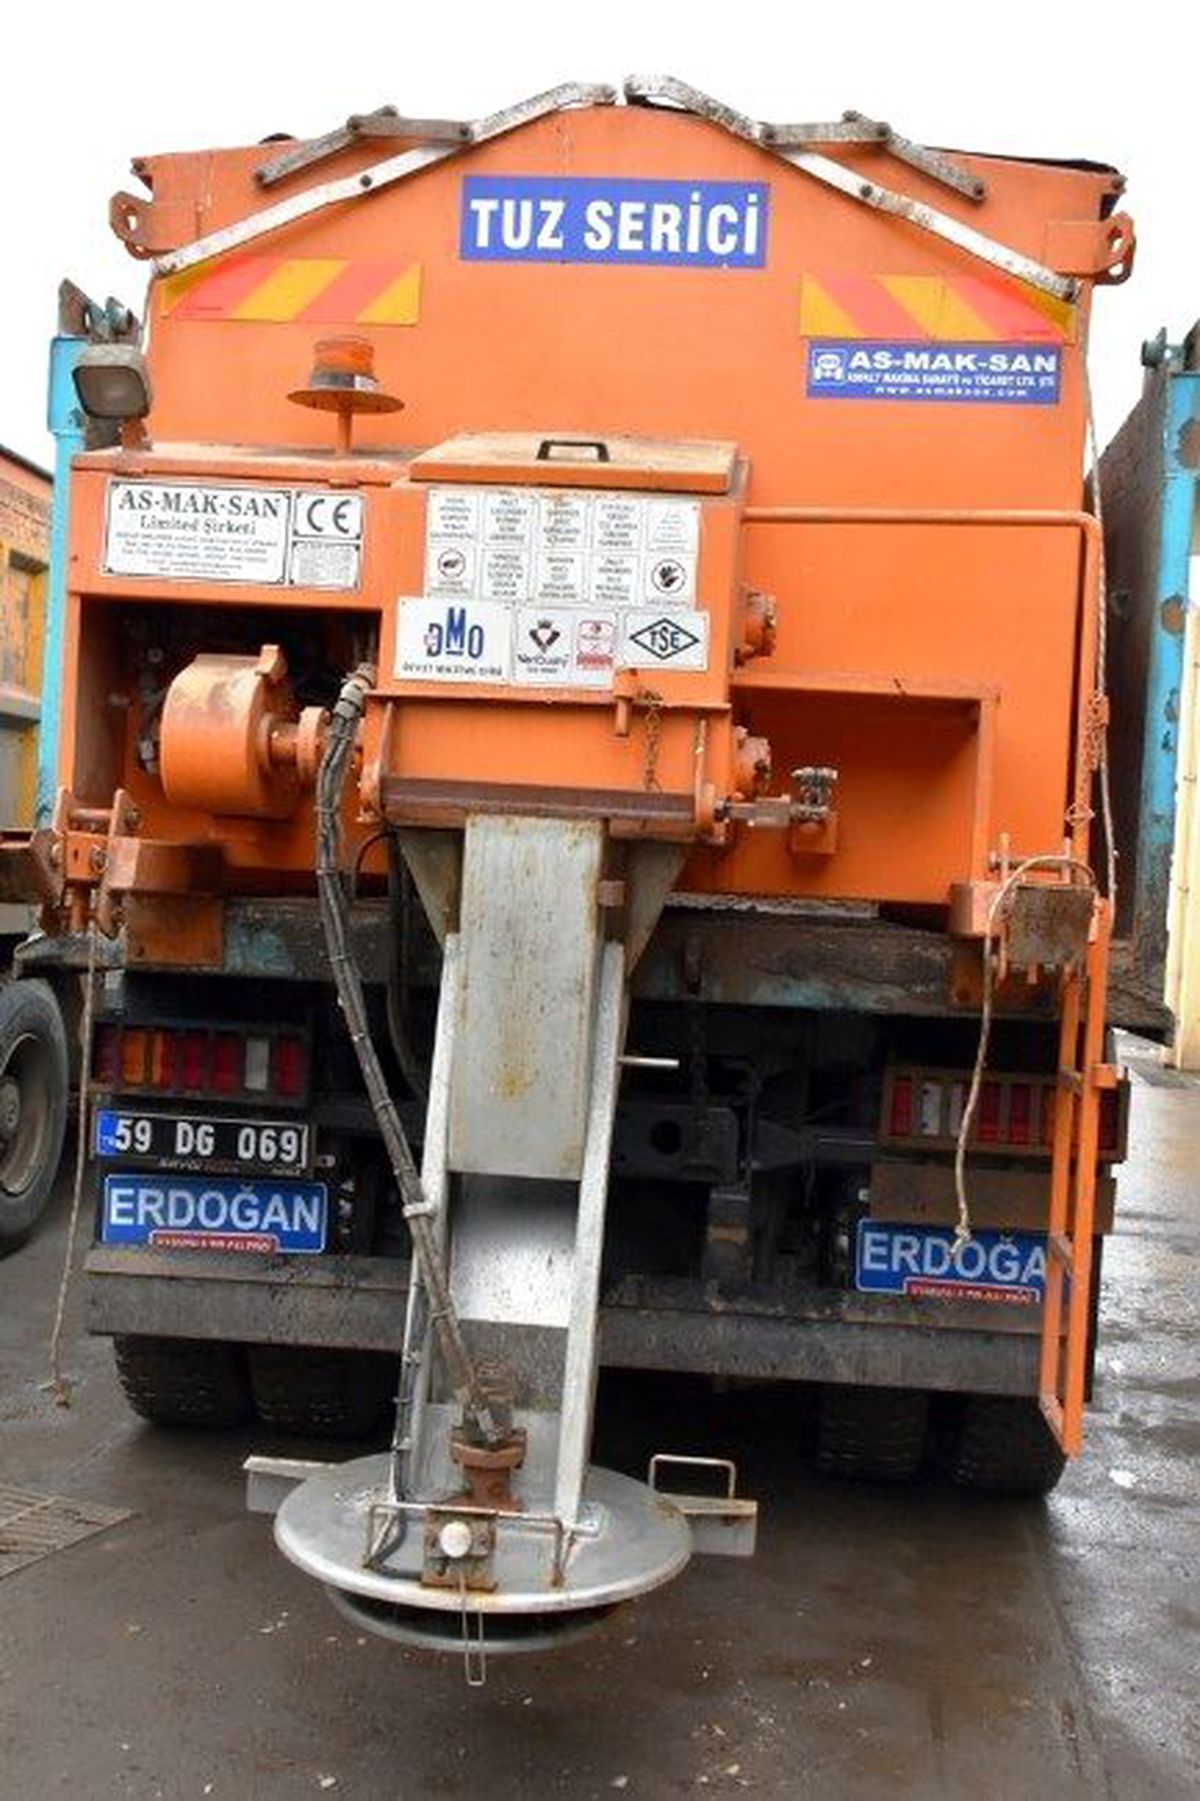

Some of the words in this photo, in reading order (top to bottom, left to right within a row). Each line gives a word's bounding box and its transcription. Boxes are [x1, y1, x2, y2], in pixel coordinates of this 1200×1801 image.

[470, 198, 566, 251] TUZ
[583, 190, 759, 256] SERİCİ
[849, 351, 1057, 373] AS-MAK-SAN
[118, 488, 281, 518] AS-MAK-SAN
[140, 514, 198, 533] Limited
[203, 517, 257, 536] Şirketi
[650, 625, 681, 652] TSE
[115, 1118, 152, 1152] 59
[175, 1121, 215, 1157] DG
[237, 1127, 299, 1163] 069
[109, 1183, 320, 1233] ERDOĞAN
[862, 1231, 1047, 1284] ERDOĞA
